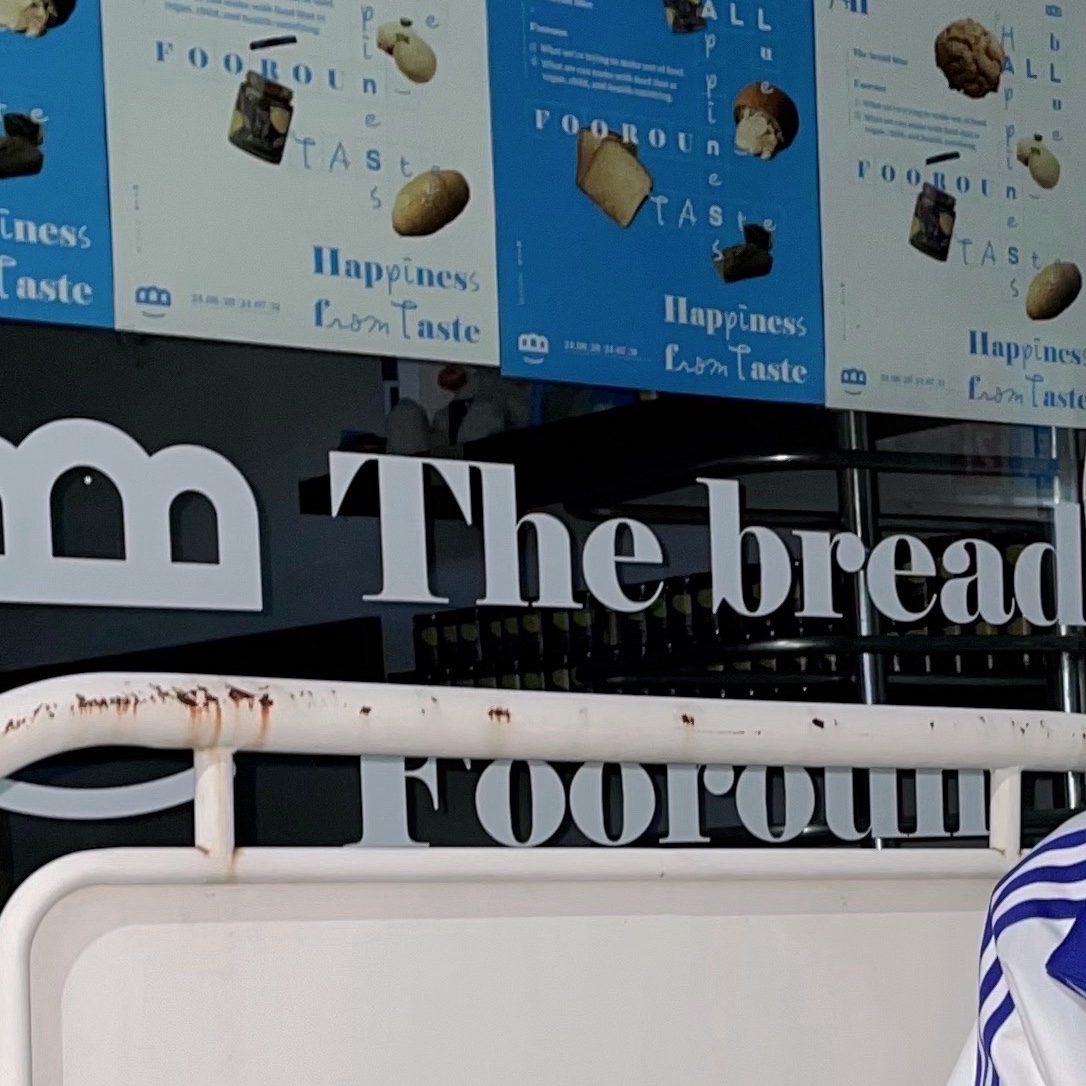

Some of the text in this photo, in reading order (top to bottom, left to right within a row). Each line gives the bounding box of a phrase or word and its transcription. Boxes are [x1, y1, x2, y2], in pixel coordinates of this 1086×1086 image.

[312, 245, 481, 294] Happiness
[313, 299, 390, 338] from
[391, 300, 481, 345] Taste
[664, 294, 808, 341] Happiness
[664, 343, 729, 378] from
[728, 344, 808, 384] Taste
[329, 451, 664, 613] The
